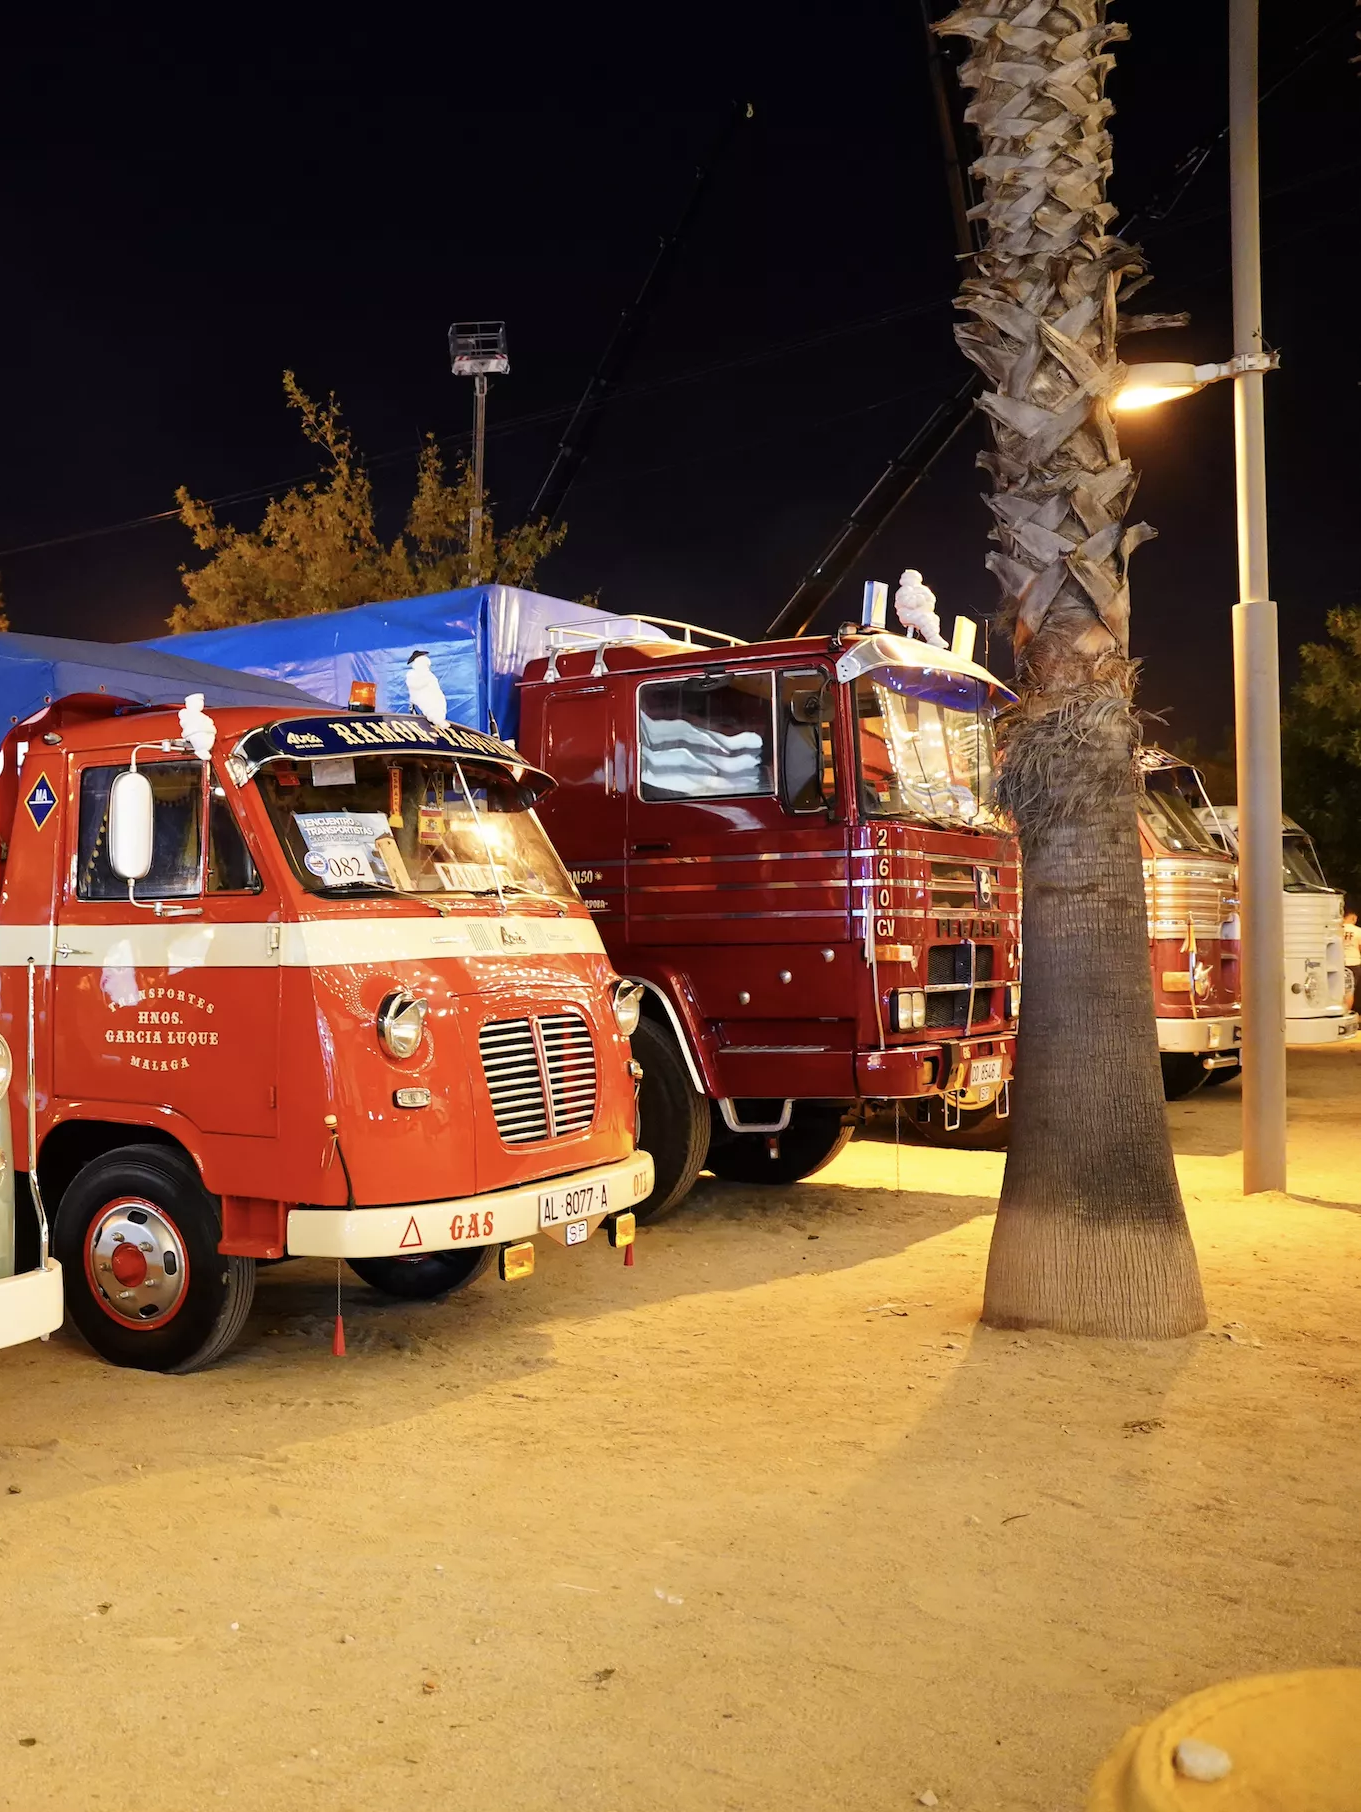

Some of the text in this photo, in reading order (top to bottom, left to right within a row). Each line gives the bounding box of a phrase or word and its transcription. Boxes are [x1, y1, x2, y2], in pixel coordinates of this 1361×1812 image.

[35, 788, 48, 801] MA
[304, 826, 375, 836] TRANSPORTISTAS
[305, 817, 355, 828] ENCUENTRO
[328, 857, 365, 877] 082
[937, 918, 1001, 938] PEGASO
[107, 987, 215, 1014] TRANSPORTES
[137, 1011, 184, 1025] HNOS.
[105, 1029, 219, 1046] GARCIA LUQUE
[129, 1055, 190, 1072] MALAGA
[449, 1211, 494, 1241] GAS
[569, 1223, 586, 1242] SP
